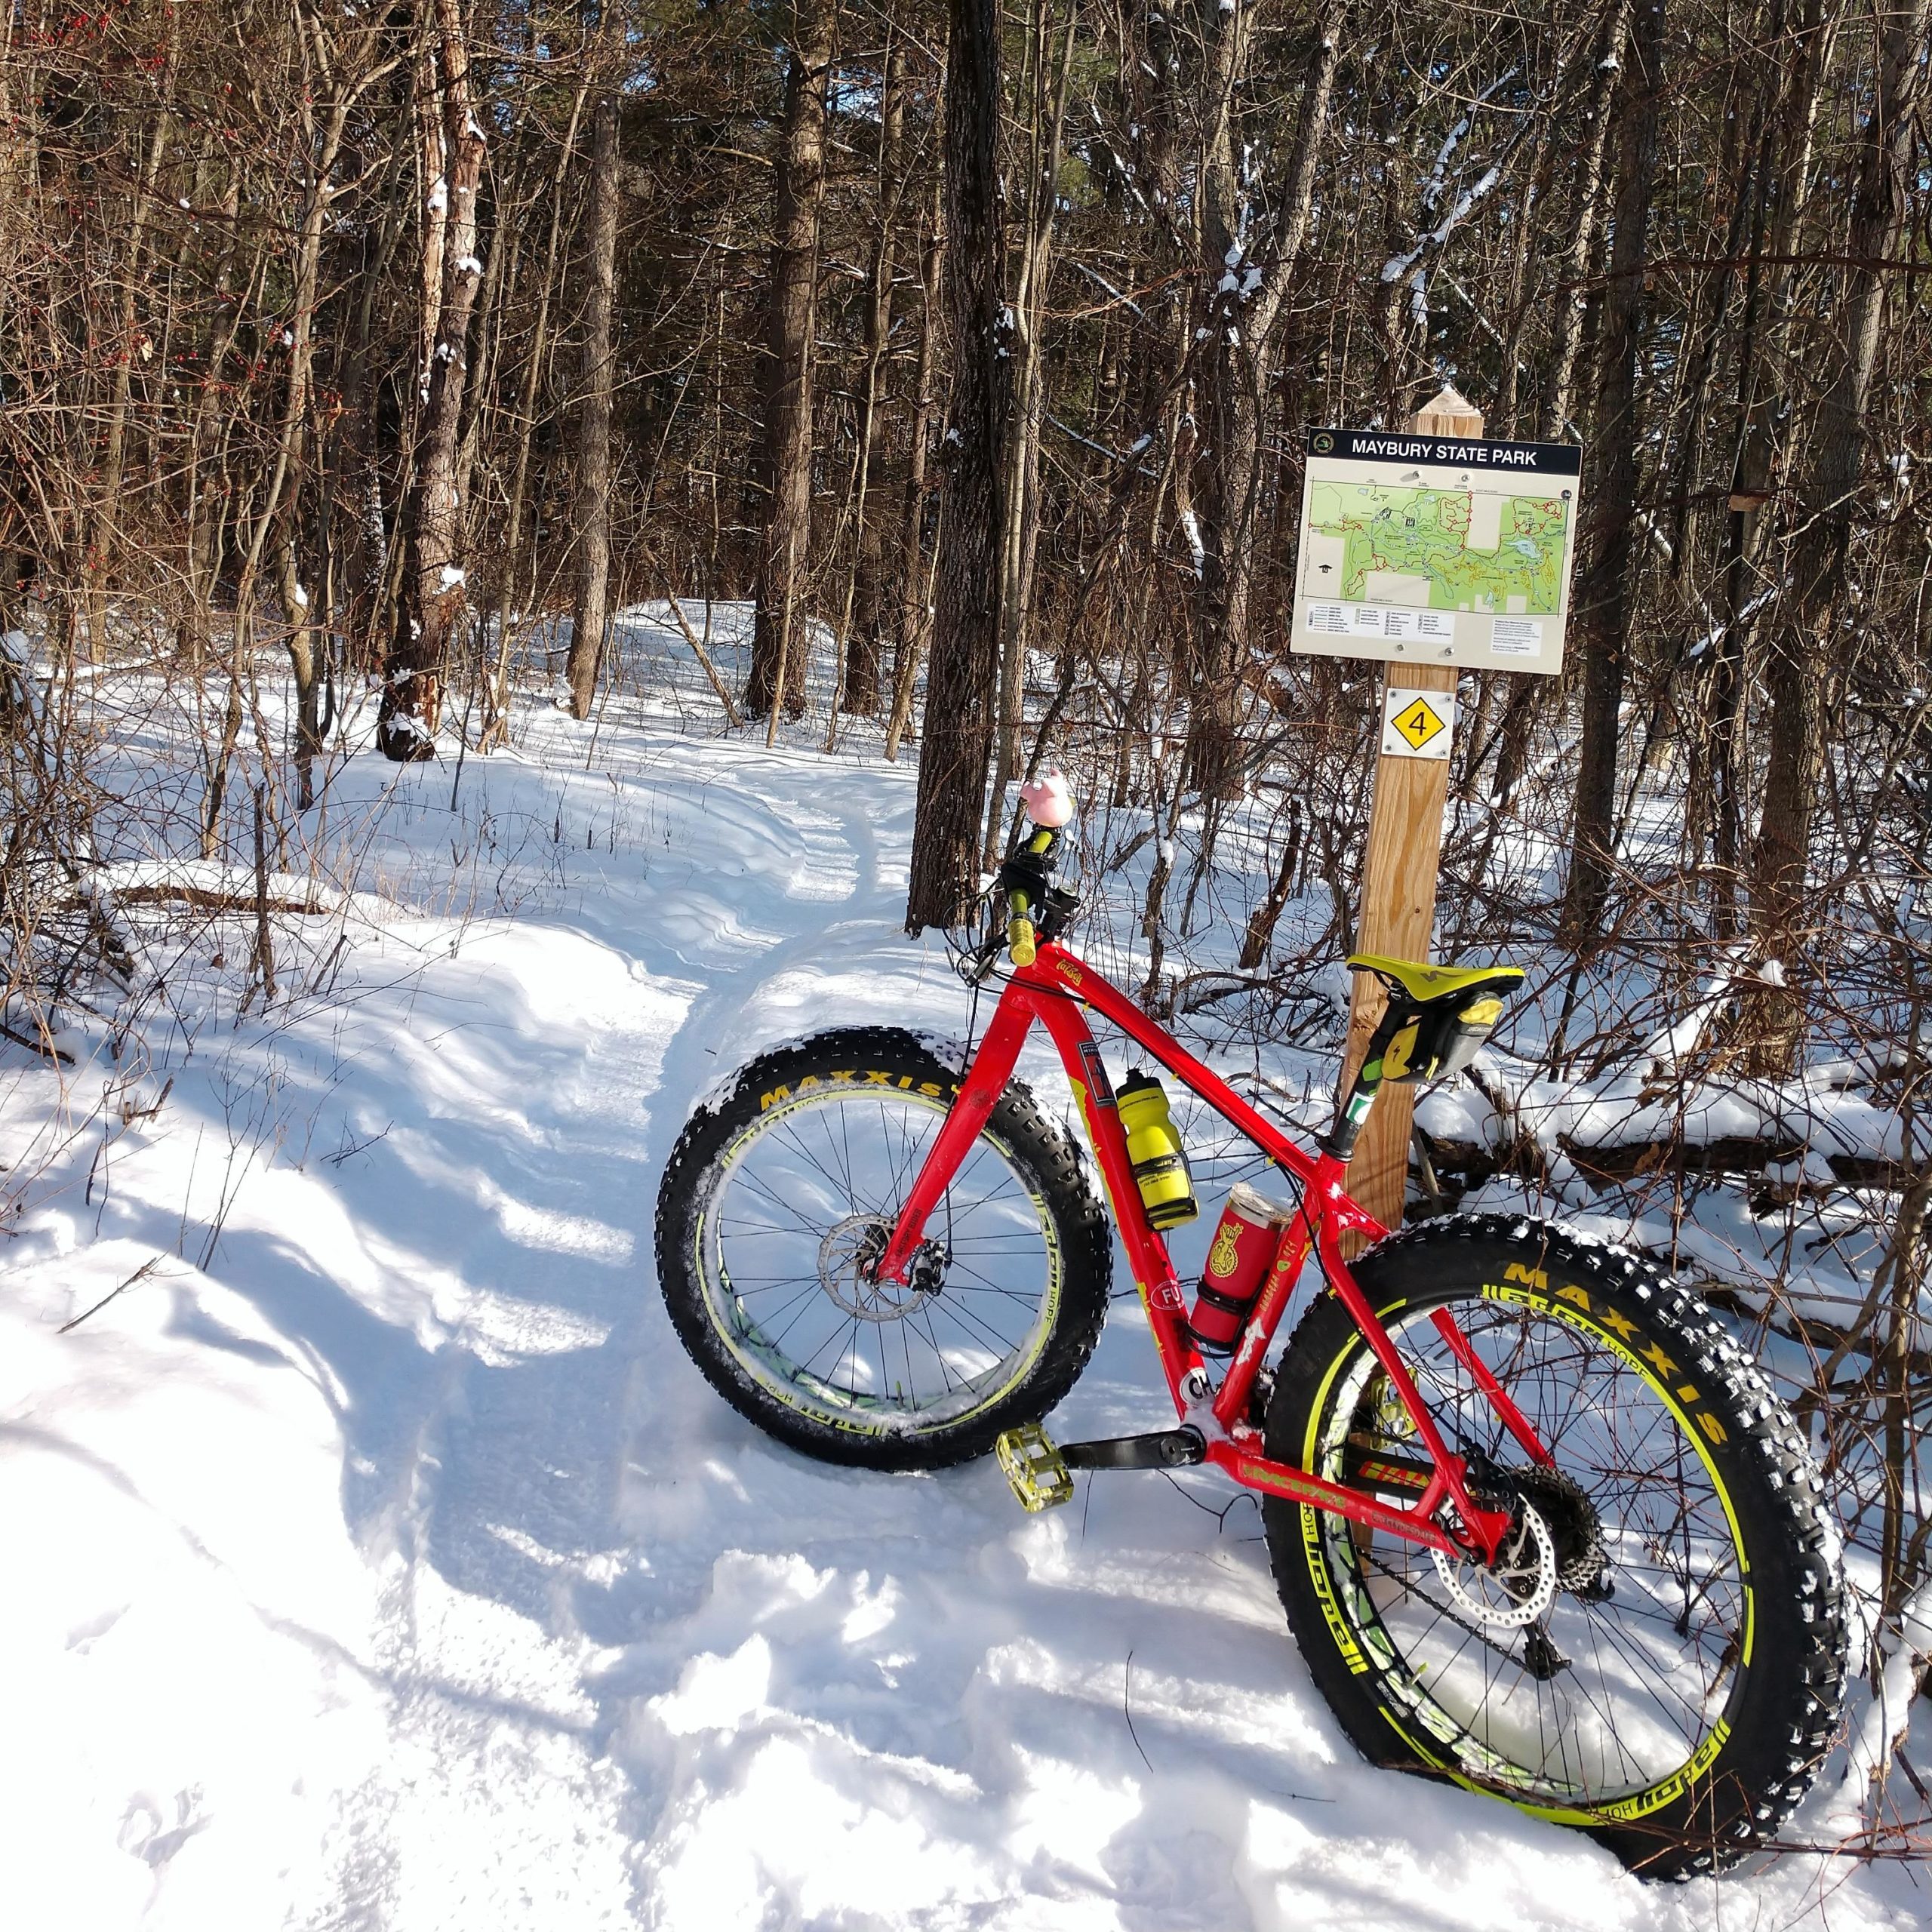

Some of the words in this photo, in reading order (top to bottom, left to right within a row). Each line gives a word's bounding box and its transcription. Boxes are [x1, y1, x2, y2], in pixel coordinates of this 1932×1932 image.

[1352, 439, 1432, 458] MAYBURY
[1435, 445, 1487, 463] STATE
[1492, 450, 1537, 466] PARK
[1408, 712, 1426, 736] 4
[760, 1070, 943, 1111] MAXXIS
[1162, 1287, 1180, 1305] FU
[1503, 1263, 1728, 1445] MAXXIS
[1606, 1340, 1650, 1378] HOPE
